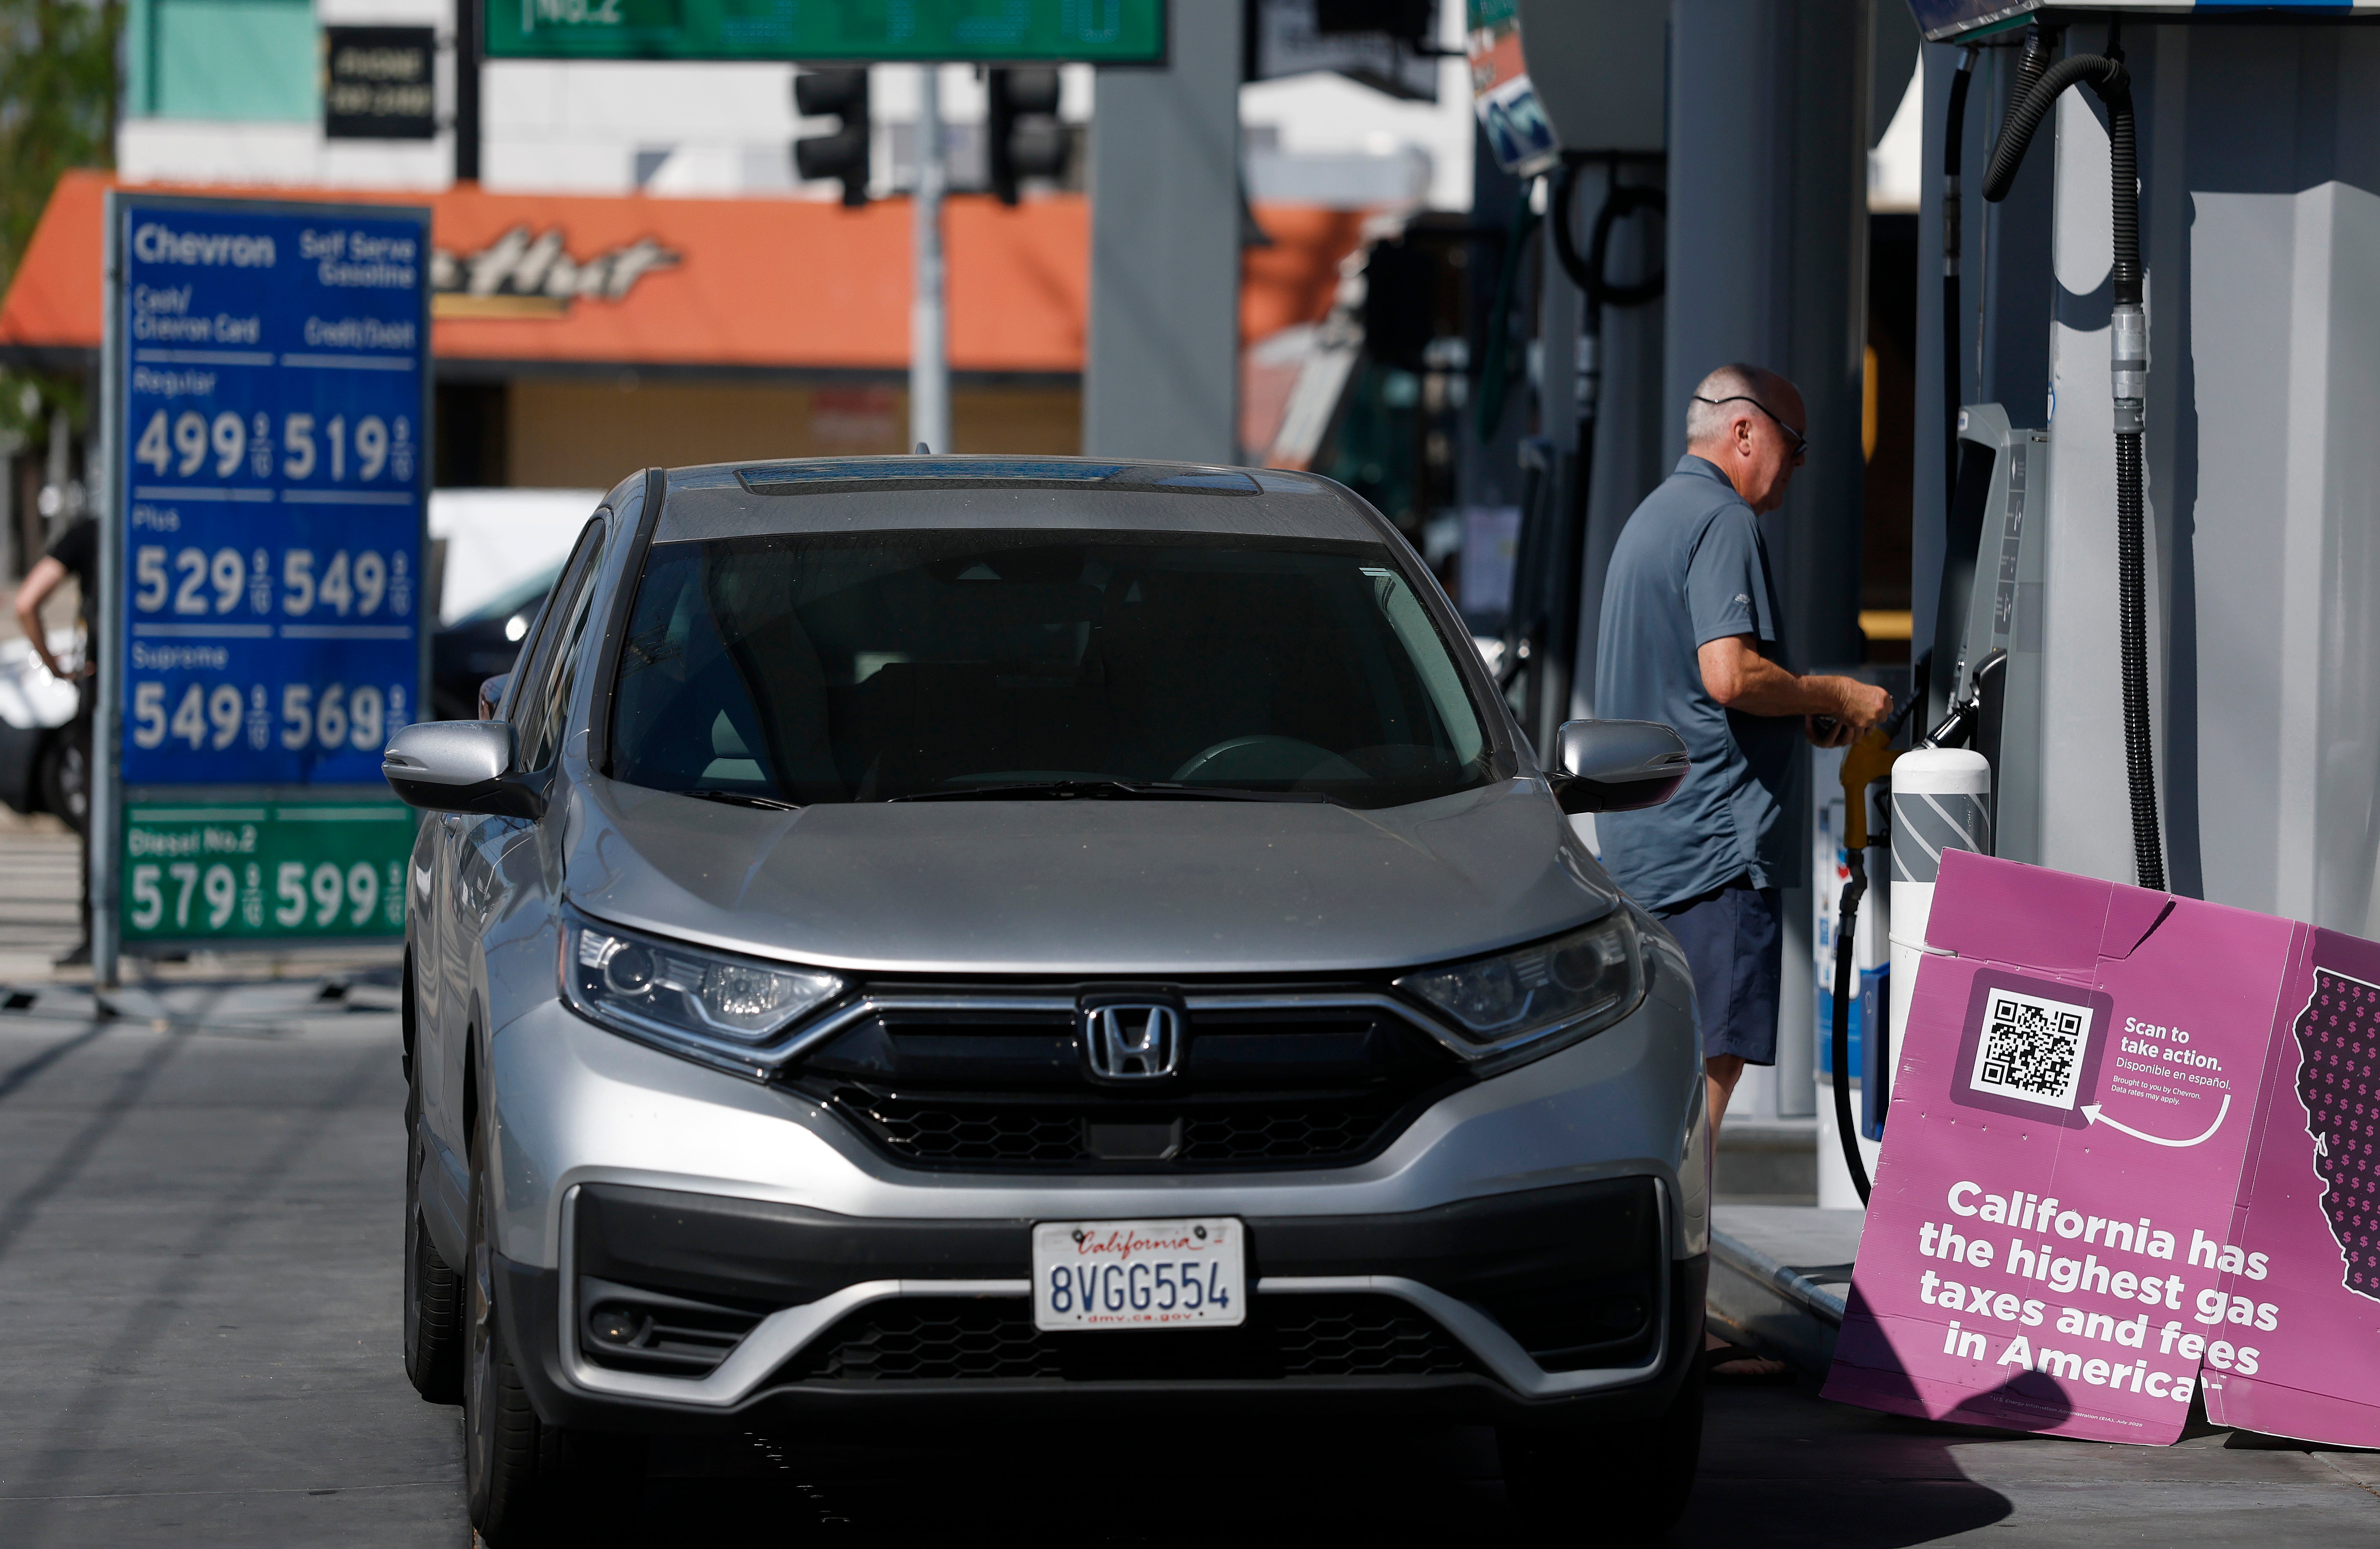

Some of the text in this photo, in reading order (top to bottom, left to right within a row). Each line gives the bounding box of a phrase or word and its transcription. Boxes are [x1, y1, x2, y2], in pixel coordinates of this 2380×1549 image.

[134, 222, 277, 268] Chevron
[299, 228, 417, 262] Self Serve
[317, 257, 417, 288] Gasoline
[133, 310, 260, 345] Chevron Card
[133, 365, 217, 399] Regular
[135, 408, 247, 478] 499
[283, 413, 389, 482] 519
[132, 503, 181, 532] Plus
[135, 545, 246, 616] 529
[283, 548, 387, 617] 549
[132, 641, 229, 672] Supreme
[133, 681, 244, 751] 549
[281, 683, 385, 751] 569
[128, 827, 200, 858] Diesel
[131, 863, 236, 930] 579
[276, 861, 379, 928] 599
[2124, 1017, 2189, 1044] Scan to
[2121, 1037, 2222, 1071] take action.
[2113, 1075, 2139, 1086] Brought
[2173, 1088, 2201, 1099] Chevron.
[2116, 1057, 2230, 1090] Disponible en español.
[2111, 1084, 2127, 1094] Data
[2128, 1088, 2144, 1097] rates
[2161, 1096, 2180, 1105] apply.
[1078, 1230, 1203, 1260] California
[1948, 1181, 2269, 1281] California has
[1051, 1262, 1229, 1313] 8VGG554
[1919, 1222, 2279, 1331] the highest gas
[1088, 1312, 1193, 1323] dmv.ca.gov
[1920, 1270, 2260, 1375] taxes and fees
[1943, 1320, 1987, 1361] in
[2025, 1403, 2057, 1412] Information
[2058, 1409, 2098, 1419] Administration
